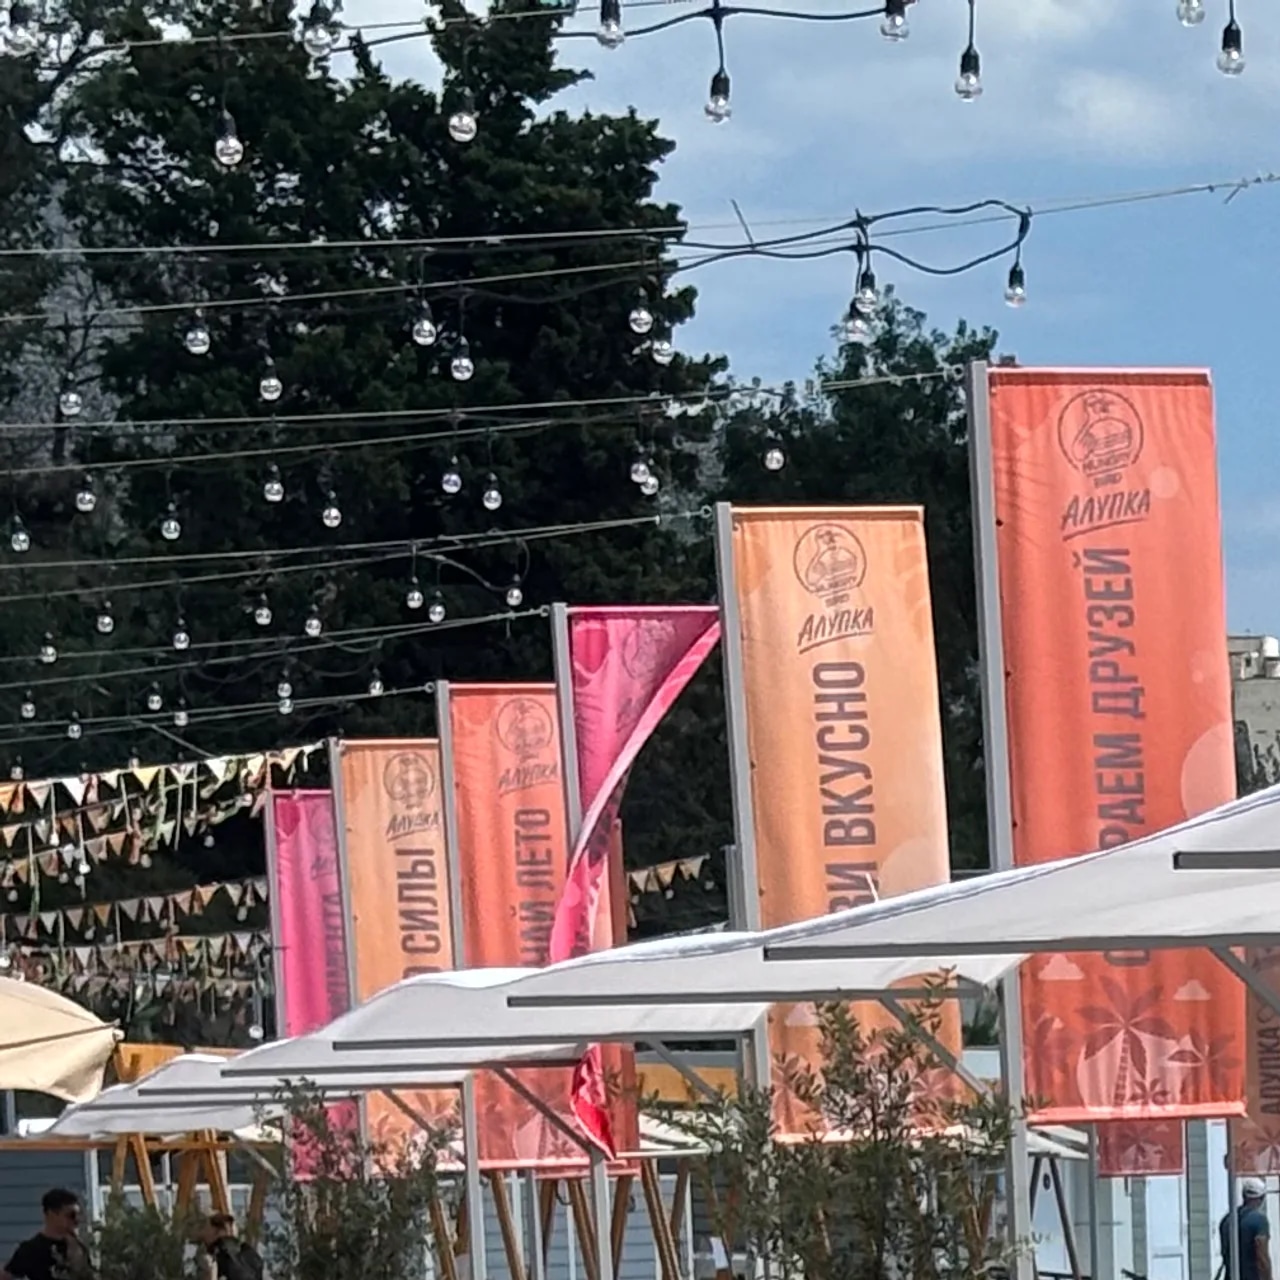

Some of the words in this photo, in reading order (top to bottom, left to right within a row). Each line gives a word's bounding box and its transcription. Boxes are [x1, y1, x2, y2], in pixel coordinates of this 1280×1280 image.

[1060, 487, 1151, 531] АЛУПКА
[796, 605, 874, 647] АЛУПКА
[1072, 547, 1146, 720] ДРУЗЕЙ
[812, 661, 877, 847] ВКУСНО
[514, 808, 555, 891] ЛЕТО
[395, 848, 441, 955] СИЛЫ
